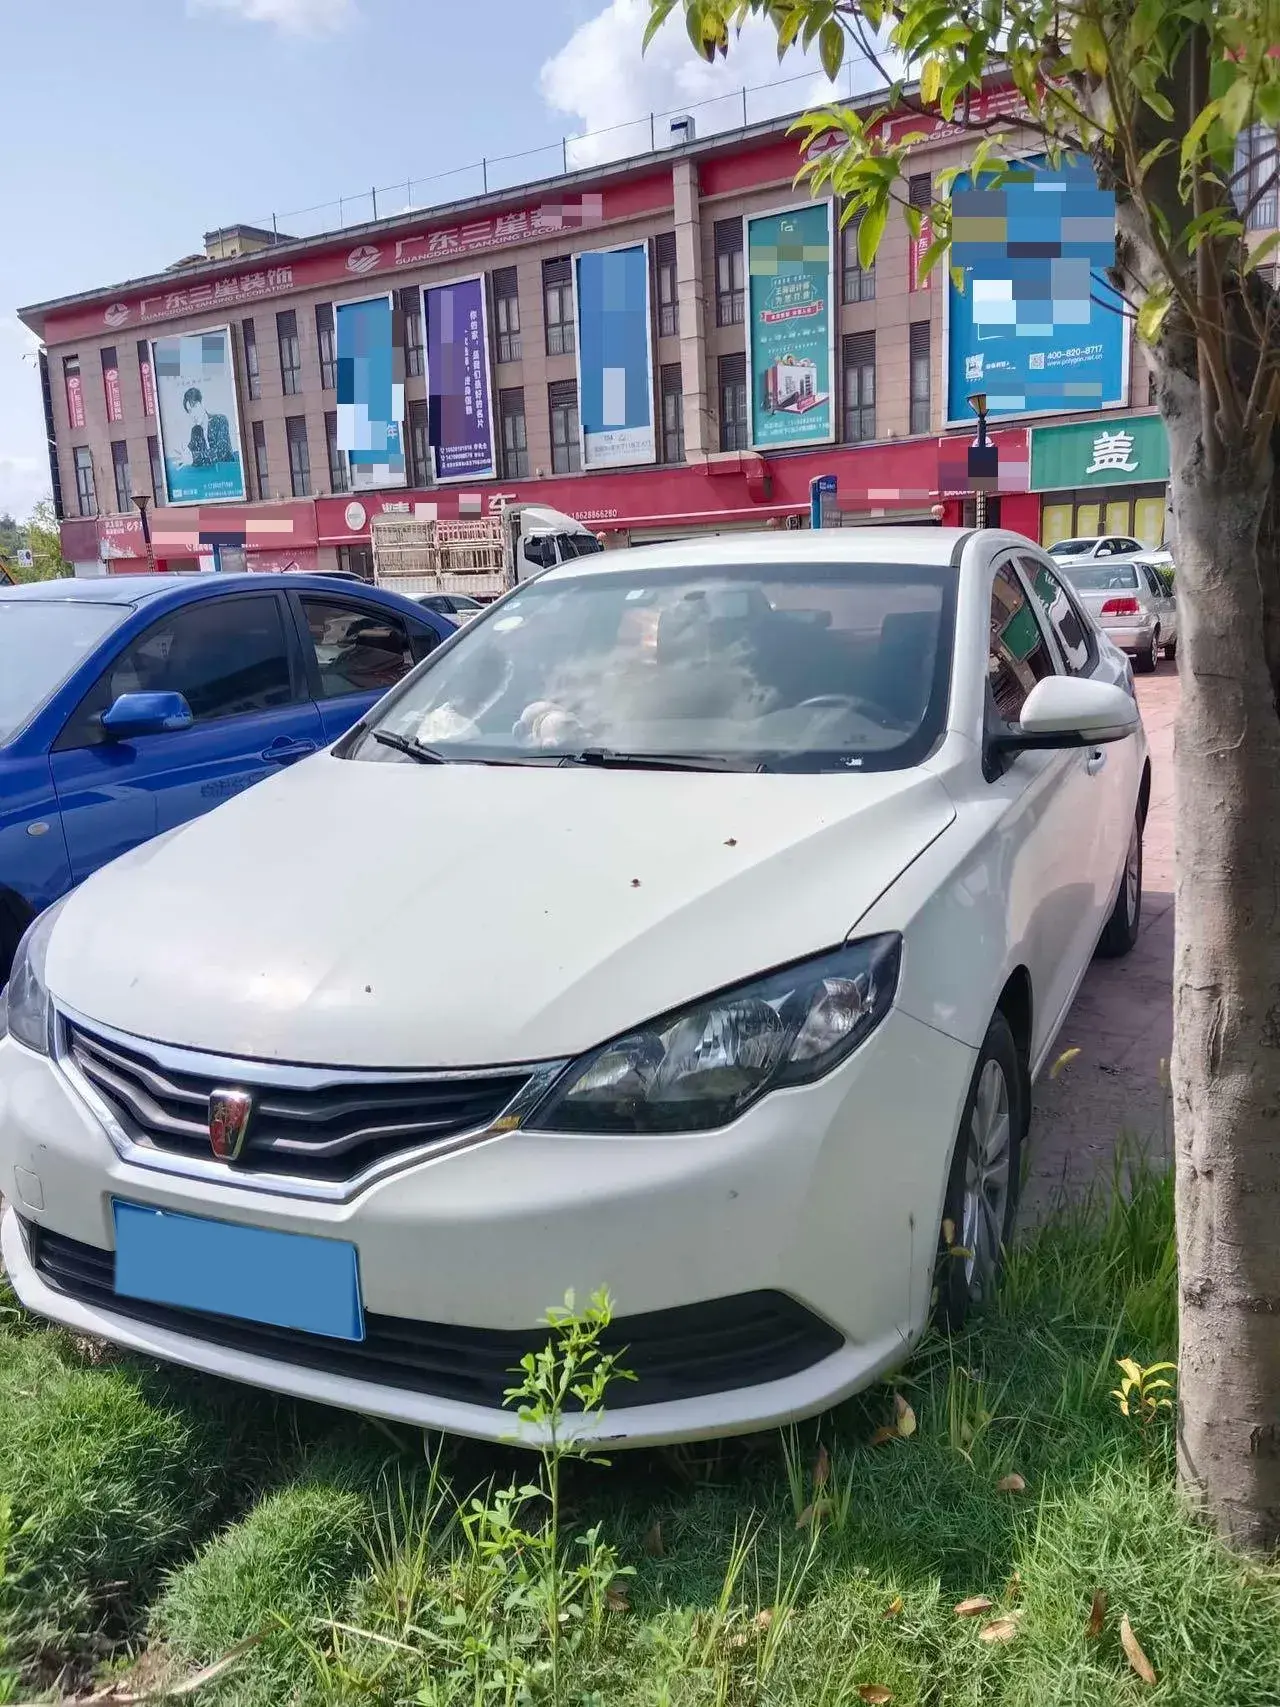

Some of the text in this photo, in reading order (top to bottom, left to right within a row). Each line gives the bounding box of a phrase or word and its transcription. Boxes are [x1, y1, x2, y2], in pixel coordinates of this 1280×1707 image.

[396, 245, 467, 265] GUANGDONG
[469, 232, 520, 249] SANXING
[235, 282, 294, 299] DECORATION
[1047, 344, 1103, 360] 400-820-8717
[1086, 430, 1139, 474] 盖
